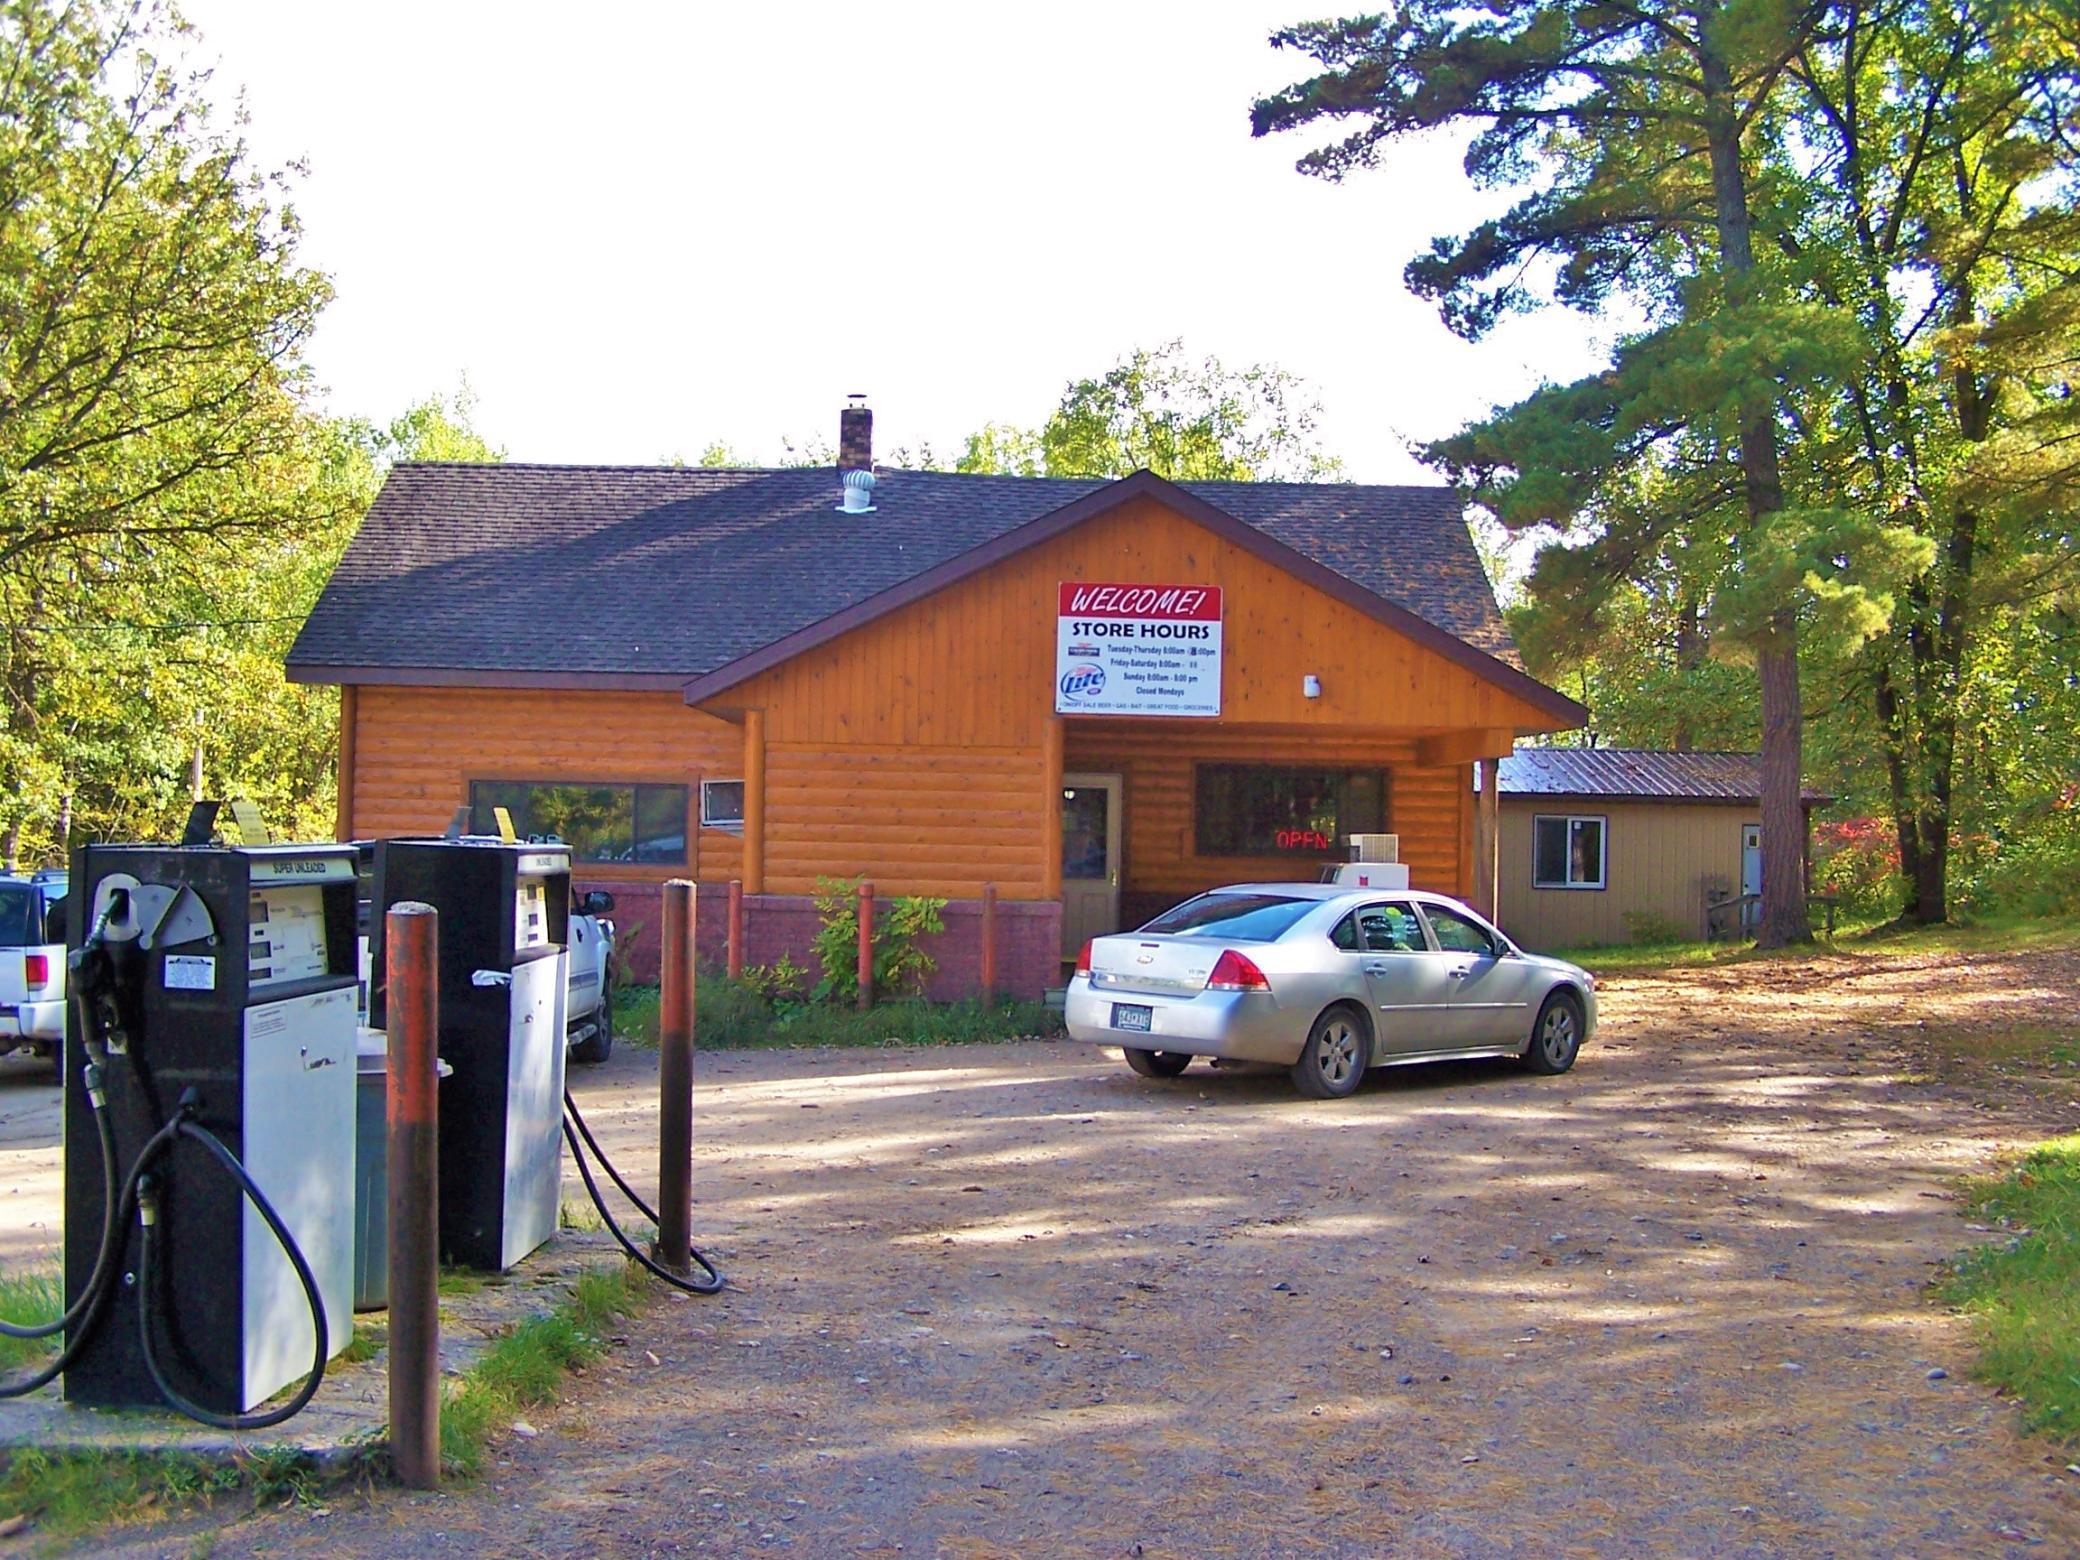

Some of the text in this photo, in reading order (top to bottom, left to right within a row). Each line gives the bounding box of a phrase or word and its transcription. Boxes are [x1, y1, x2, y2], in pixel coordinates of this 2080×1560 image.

[1071, 587, 1206, 616] WELCOME!
[1072, 622, 1209, 639] STORE HOURS
[1107, 644, 1162, 656] Tuesday-Thursday
[1110, 658, 1157, 669] Friday-Saturday
[1123, 672, 1145, 683] Sunday
[1135, 686, 1185, 697] Closed Mondays
[1276, 831, 1328, 850] OPEN
[272, 862, 326, 874] SUPER UNLEADED
